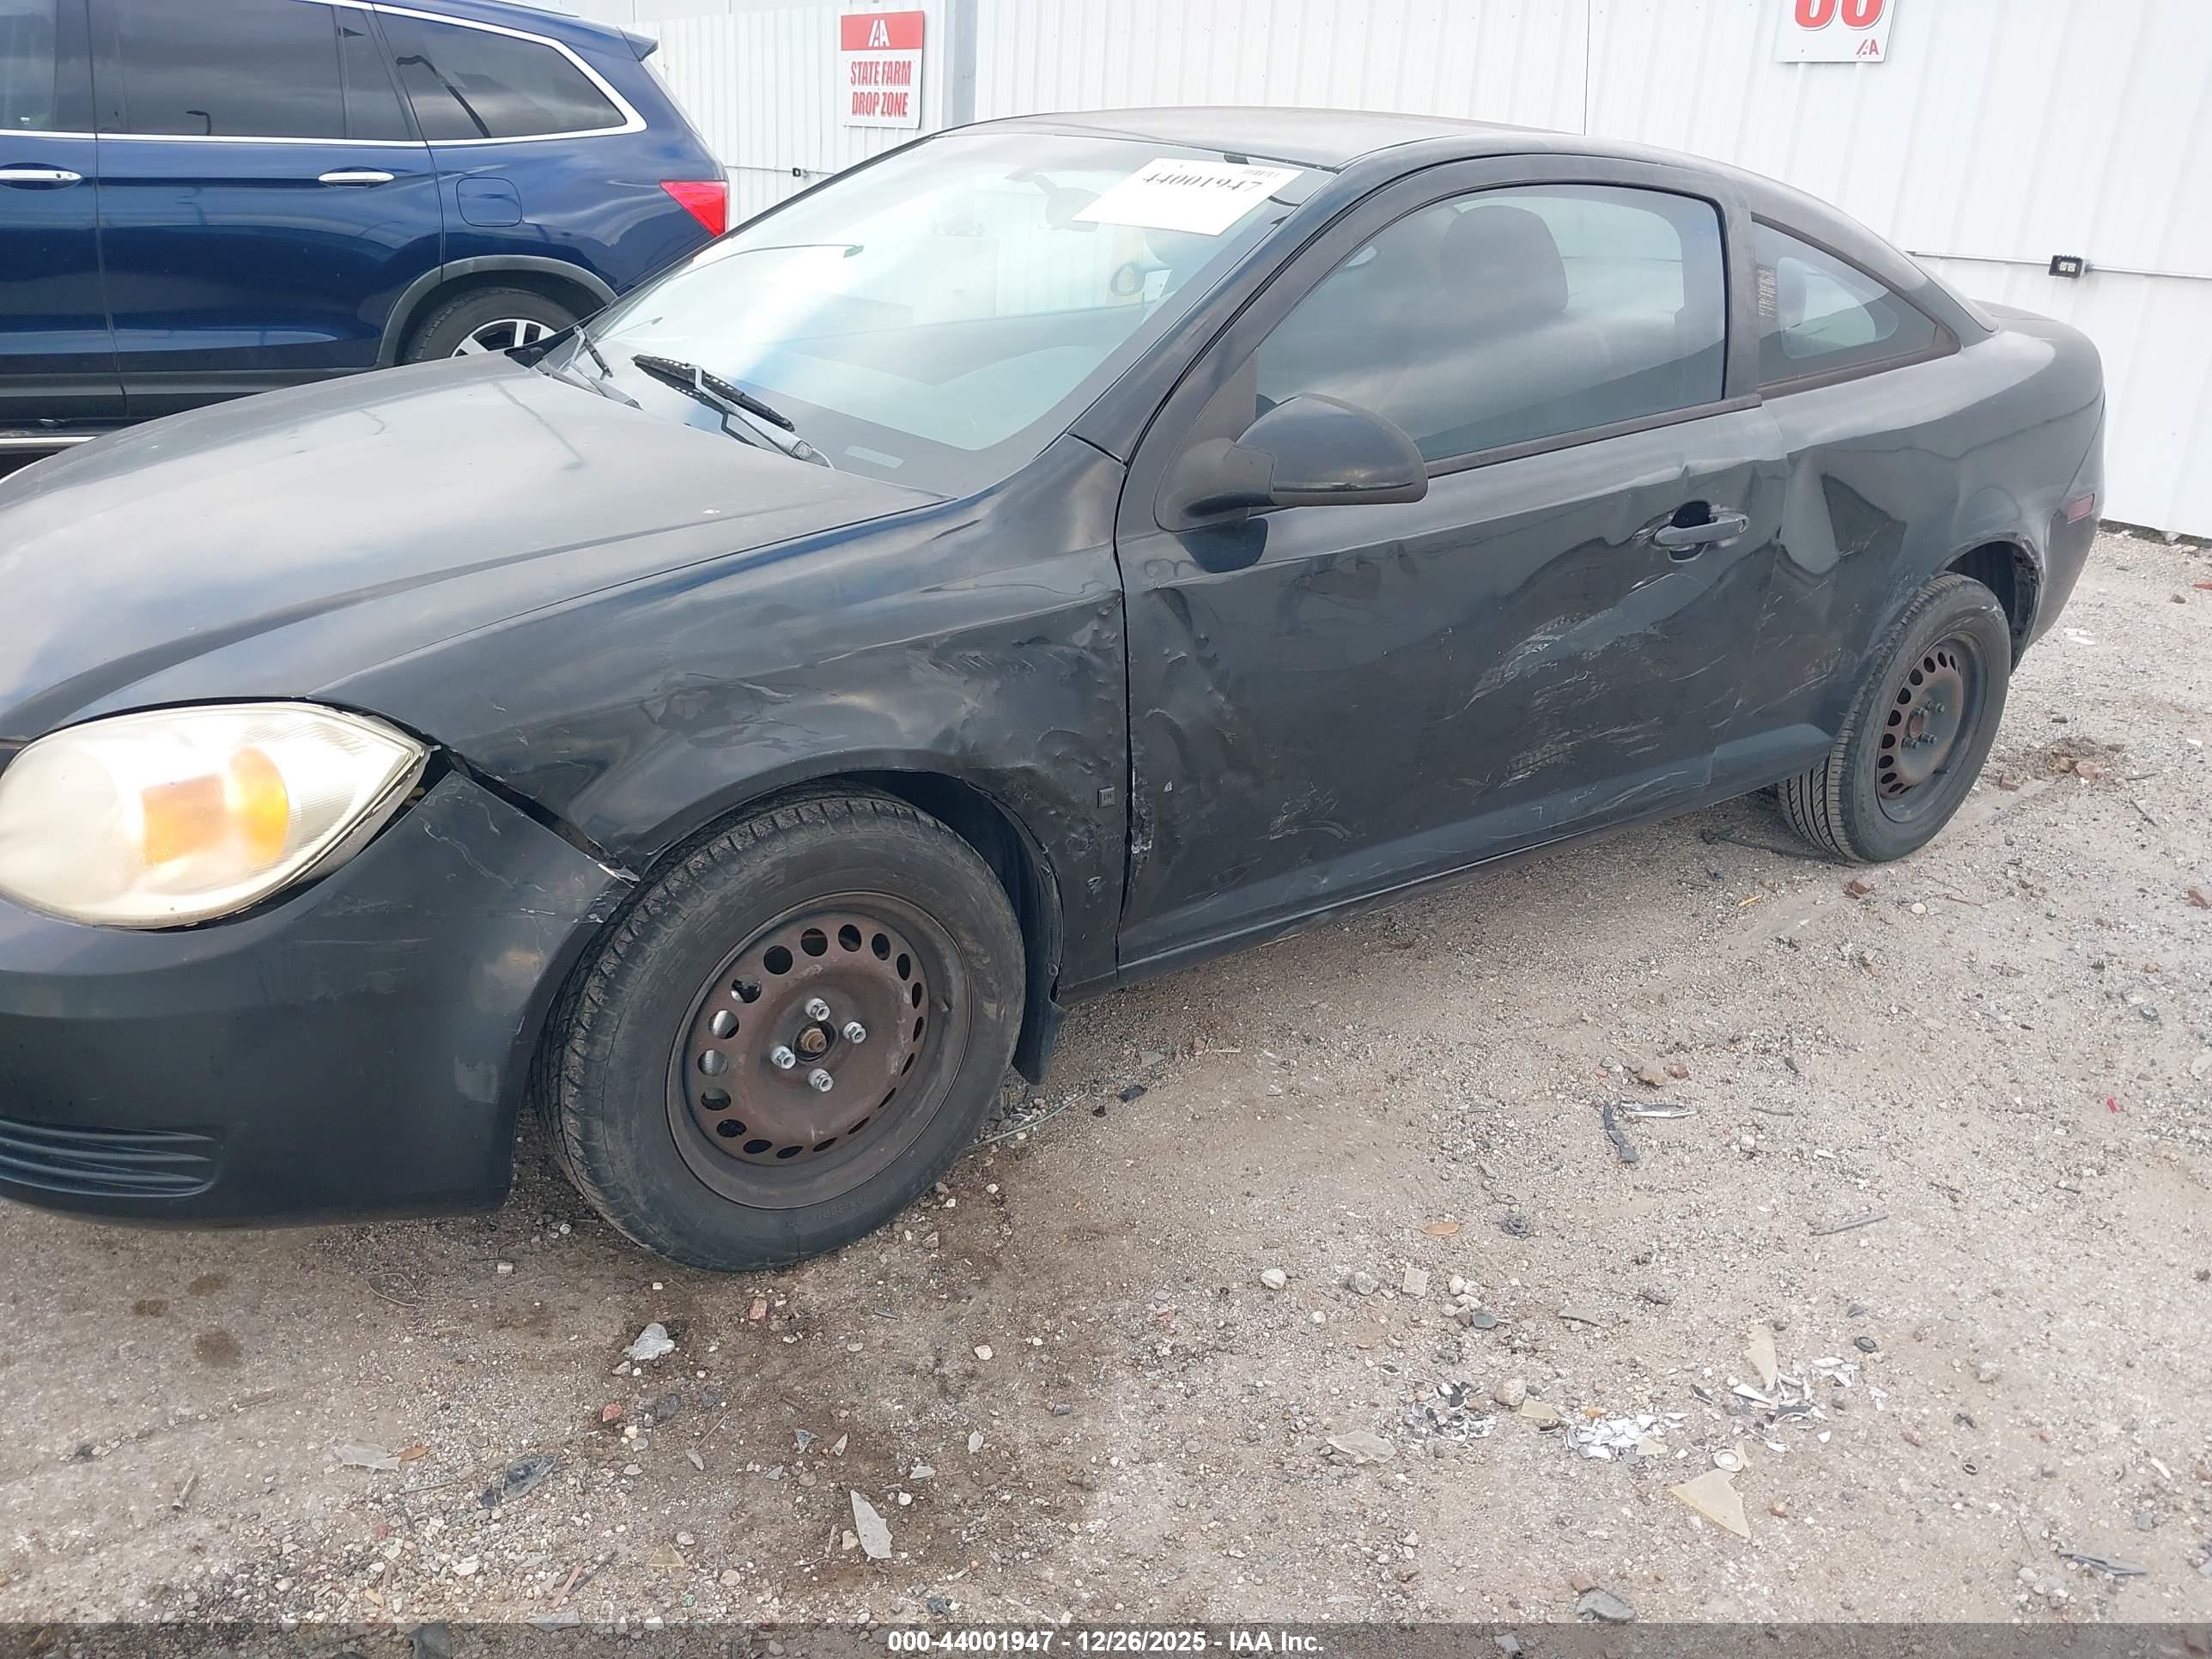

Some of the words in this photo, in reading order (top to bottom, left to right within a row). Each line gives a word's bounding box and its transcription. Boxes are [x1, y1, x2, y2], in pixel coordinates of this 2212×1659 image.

[850, 61, 879, 86] STATE
[881, 60, 912, 86] FARM
[852, 91, 879, 117] DROP
[880, 92, 908, 118] ZONE
